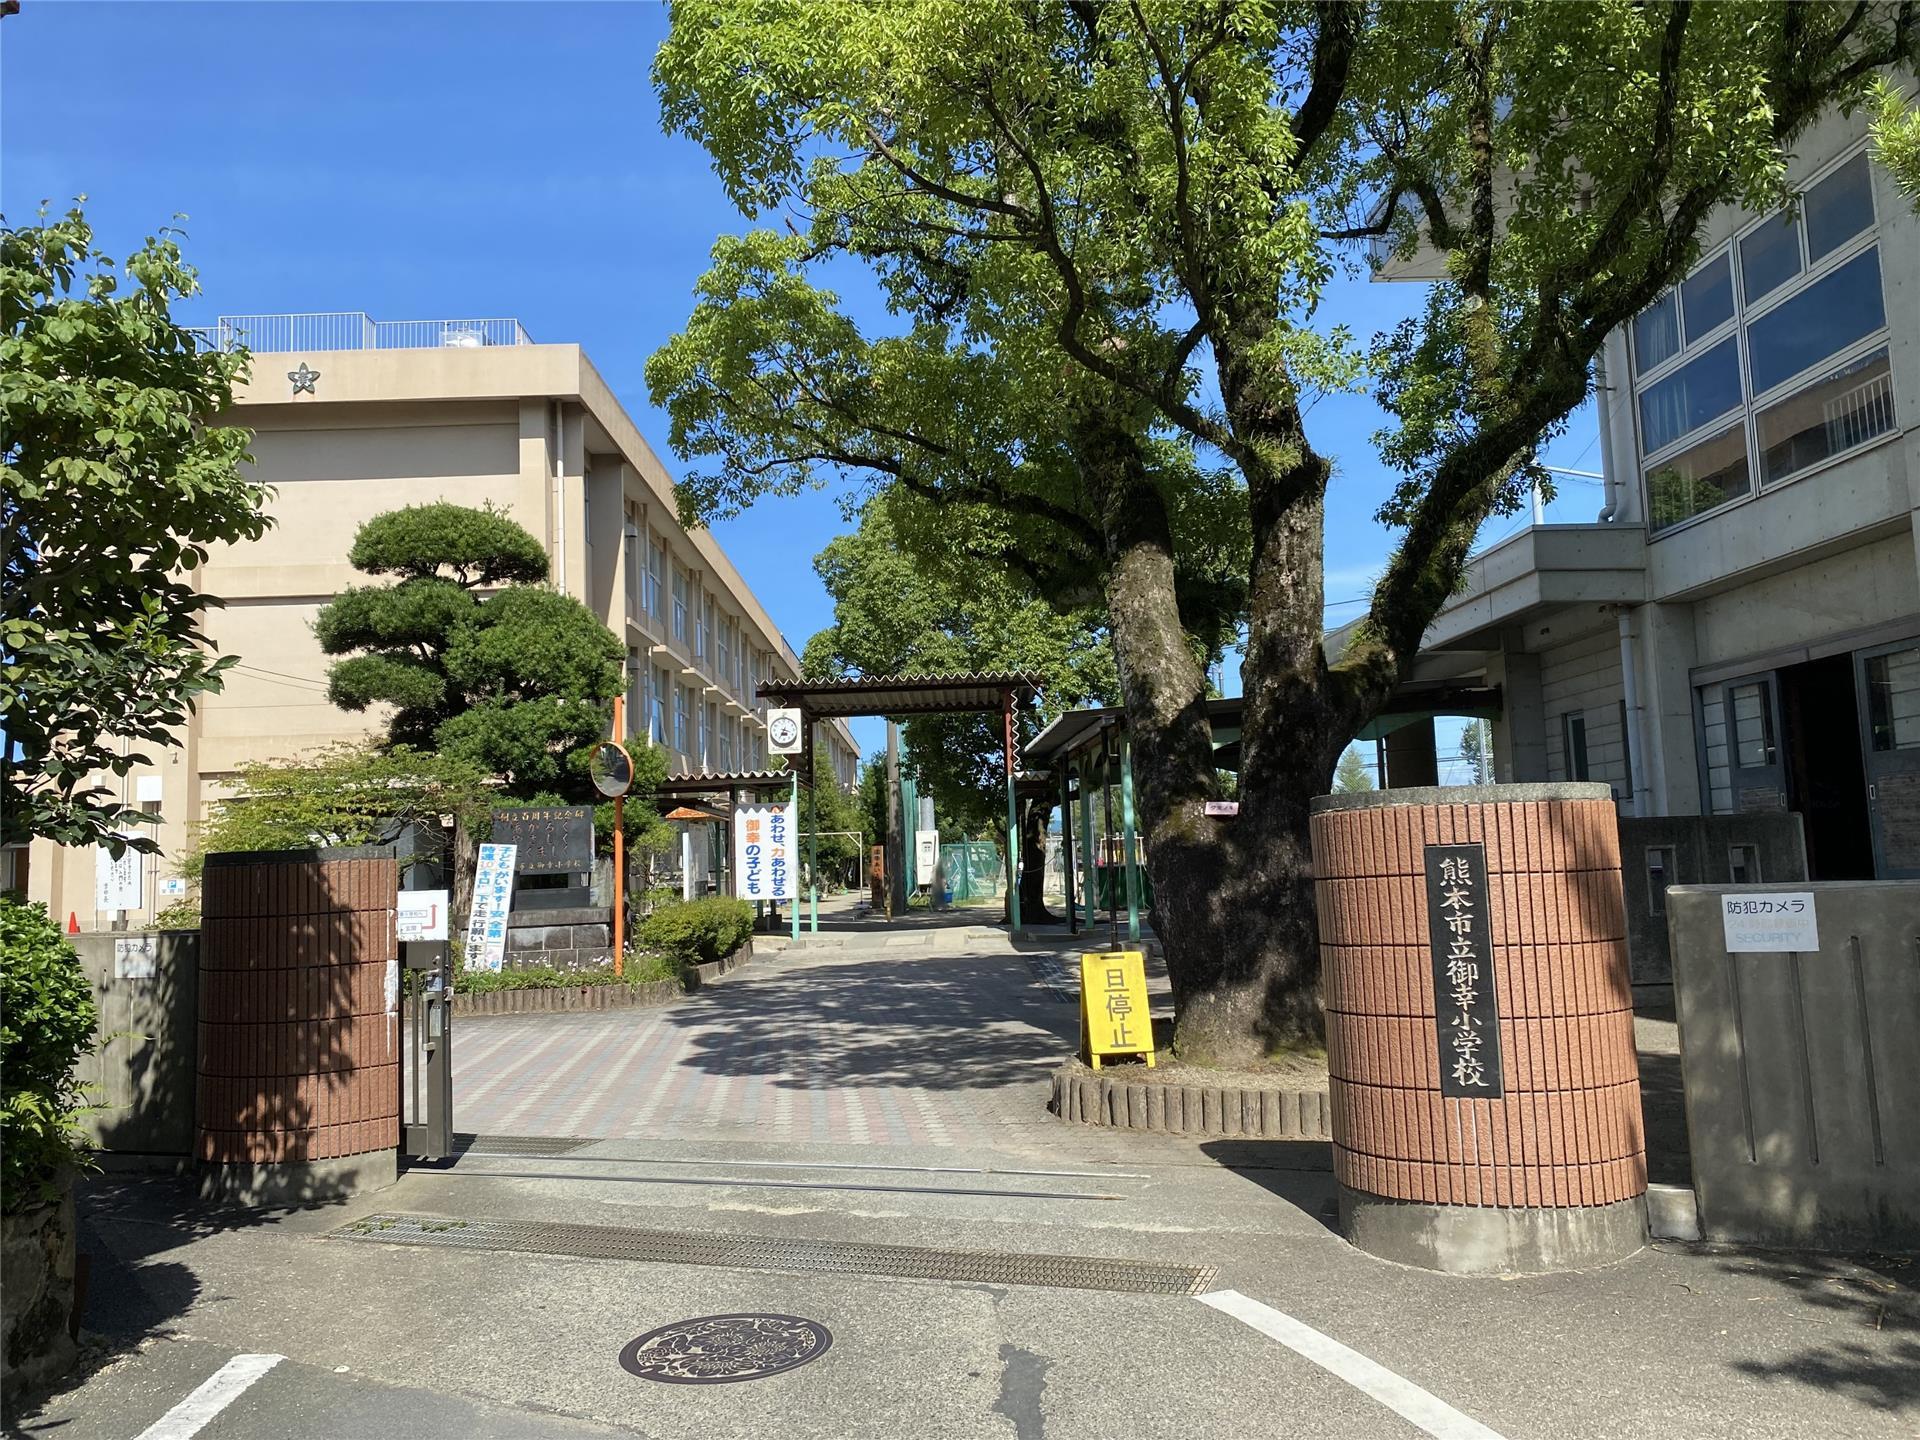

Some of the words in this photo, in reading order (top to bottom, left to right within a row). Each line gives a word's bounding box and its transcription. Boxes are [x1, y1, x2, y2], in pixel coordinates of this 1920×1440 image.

[745, 819, 761, 895] 御幸の子ども
[1726, 899, 1806, 915] 防犯カメラ
[1103, 968, 1137, 1049] 旦停止
[1439, 855, 1490, 1088] 熊本市立御幸小学校
